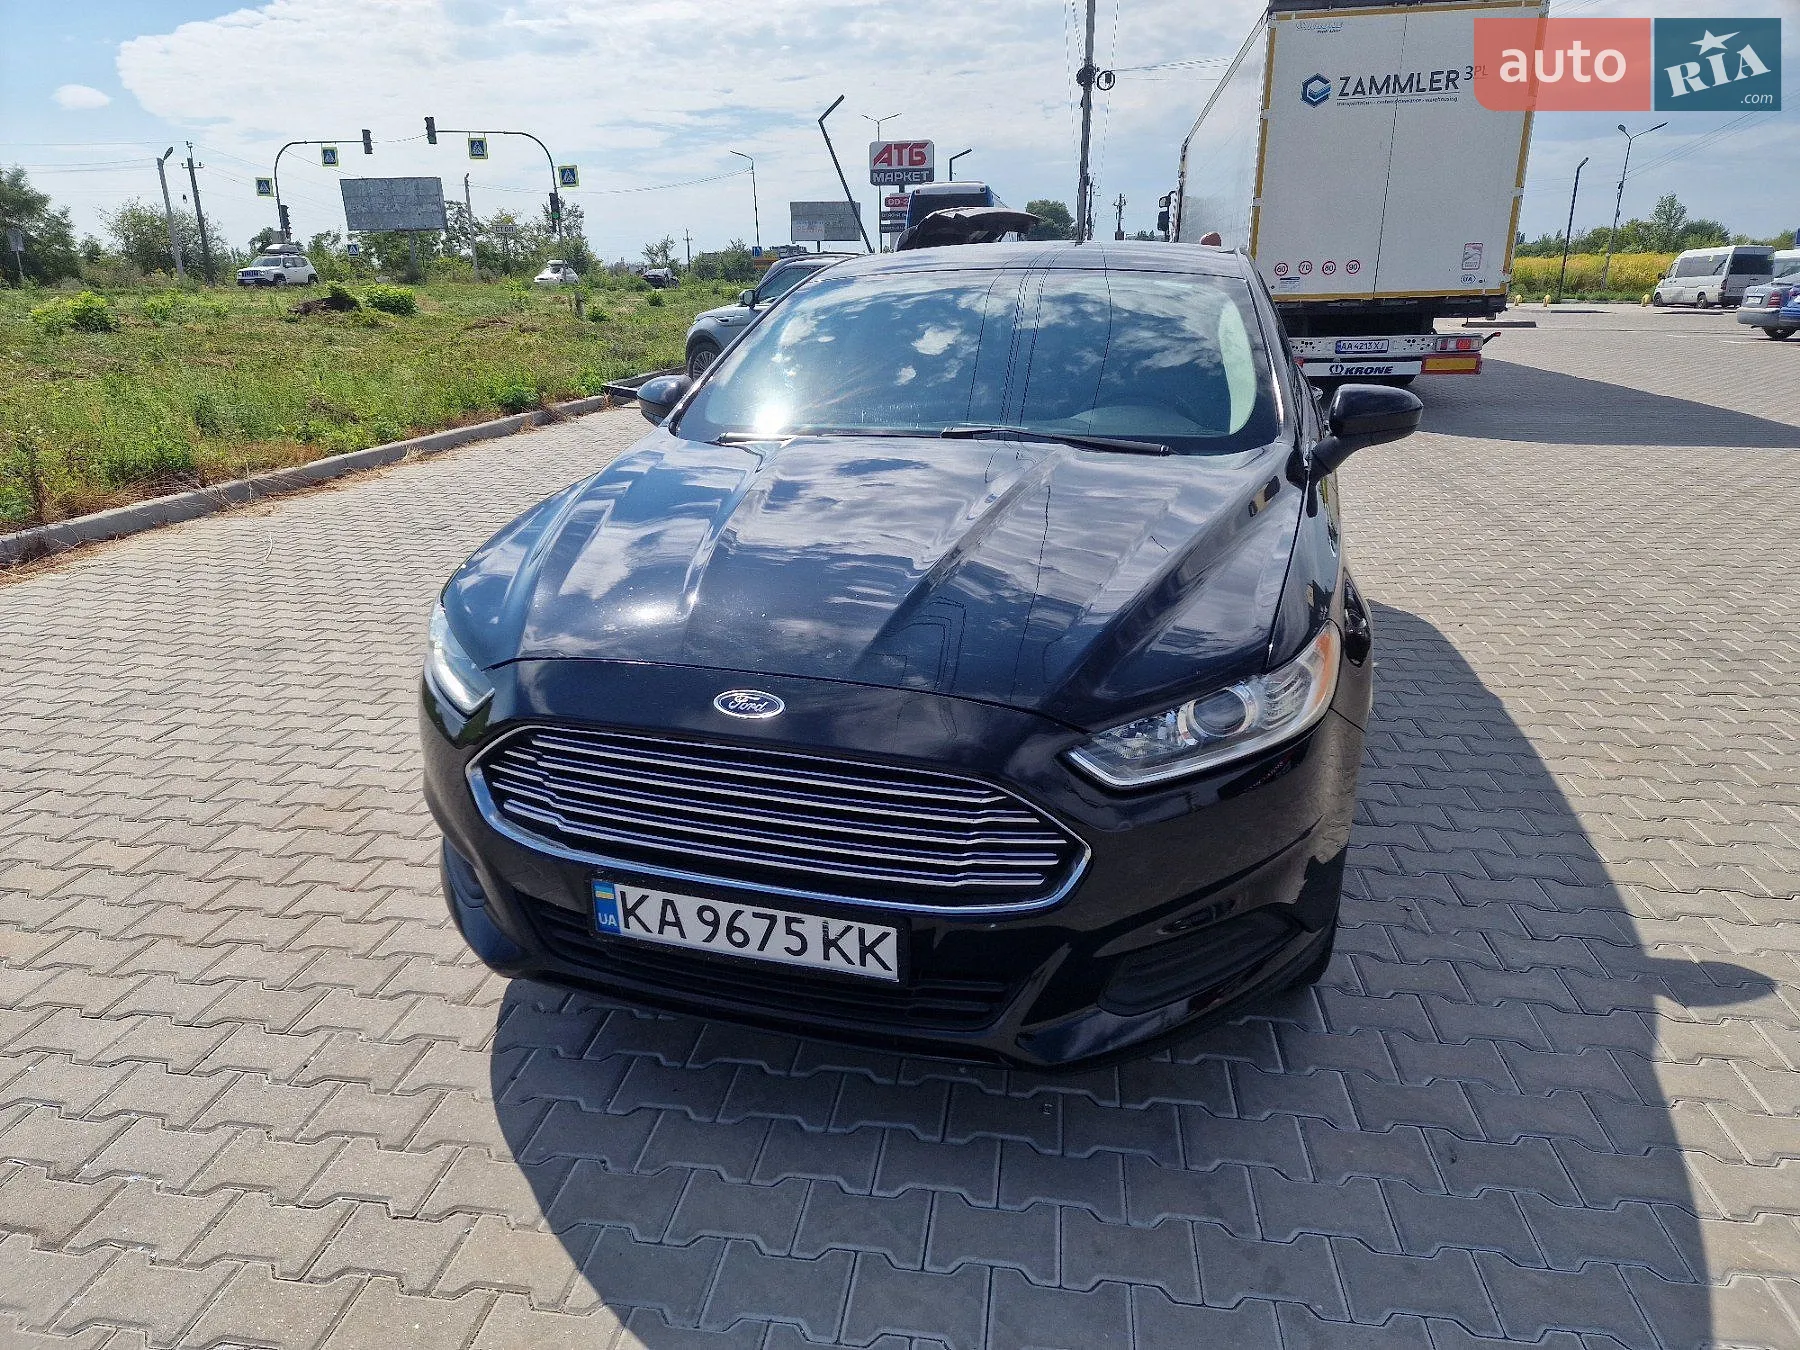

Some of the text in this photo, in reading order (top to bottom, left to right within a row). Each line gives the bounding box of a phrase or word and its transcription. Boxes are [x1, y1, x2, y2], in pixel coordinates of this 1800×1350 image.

[1338, 65, 1489, 97] ZAMMLER 3PL
[873, 142, 929, 167] АТБ
[873, 171, 930, 183] МАРКЕТ
[1344, 365, 1394, 375] KRONE
[728, 694, 769, 713] Ford
[599, 890, 893, 971] UA KA 9675 KK
